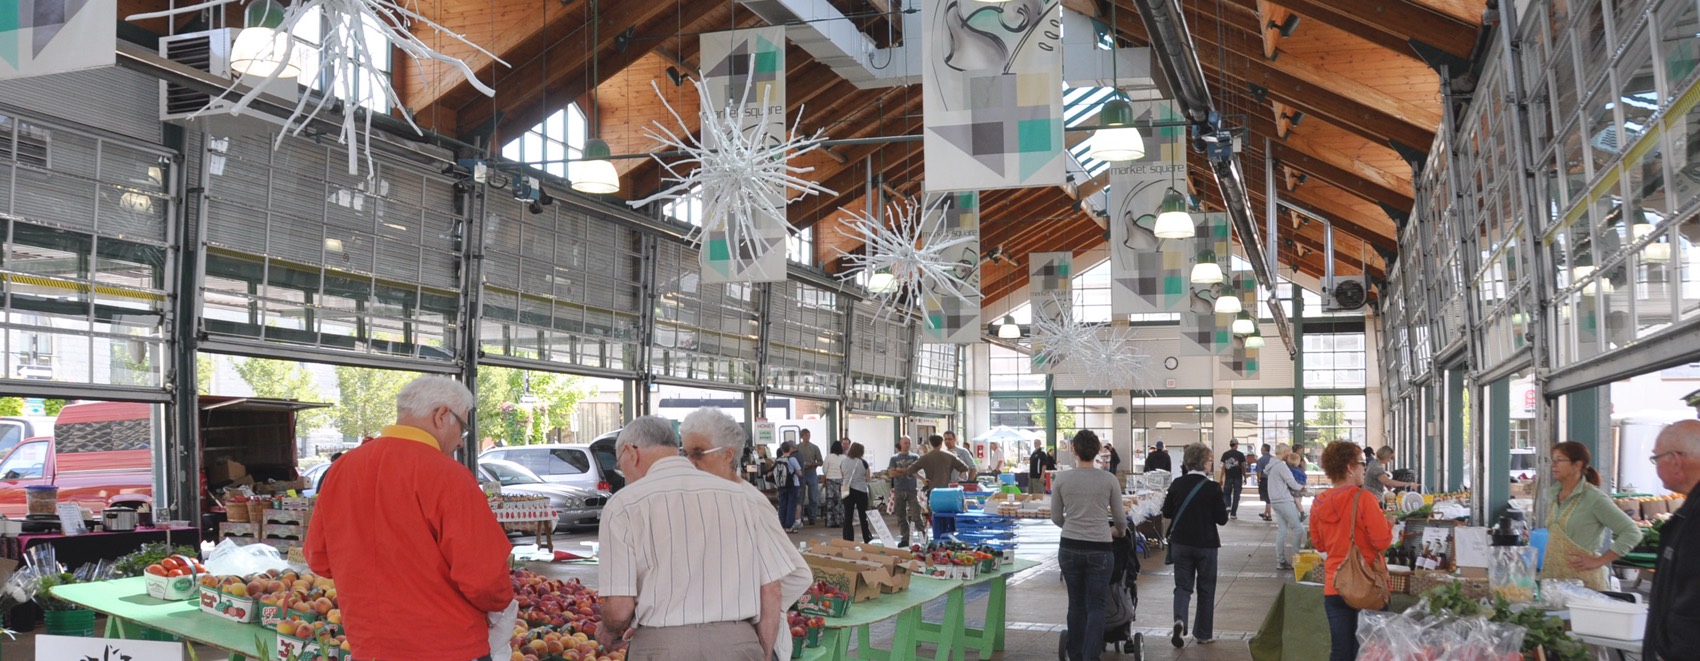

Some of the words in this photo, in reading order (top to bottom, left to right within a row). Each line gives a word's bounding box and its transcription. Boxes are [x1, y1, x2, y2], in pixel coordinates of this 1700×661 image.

[1110, 165, 1147, 175] market
[1150, 164, 1184, 174] square
[952, 229, 977, 237] square
